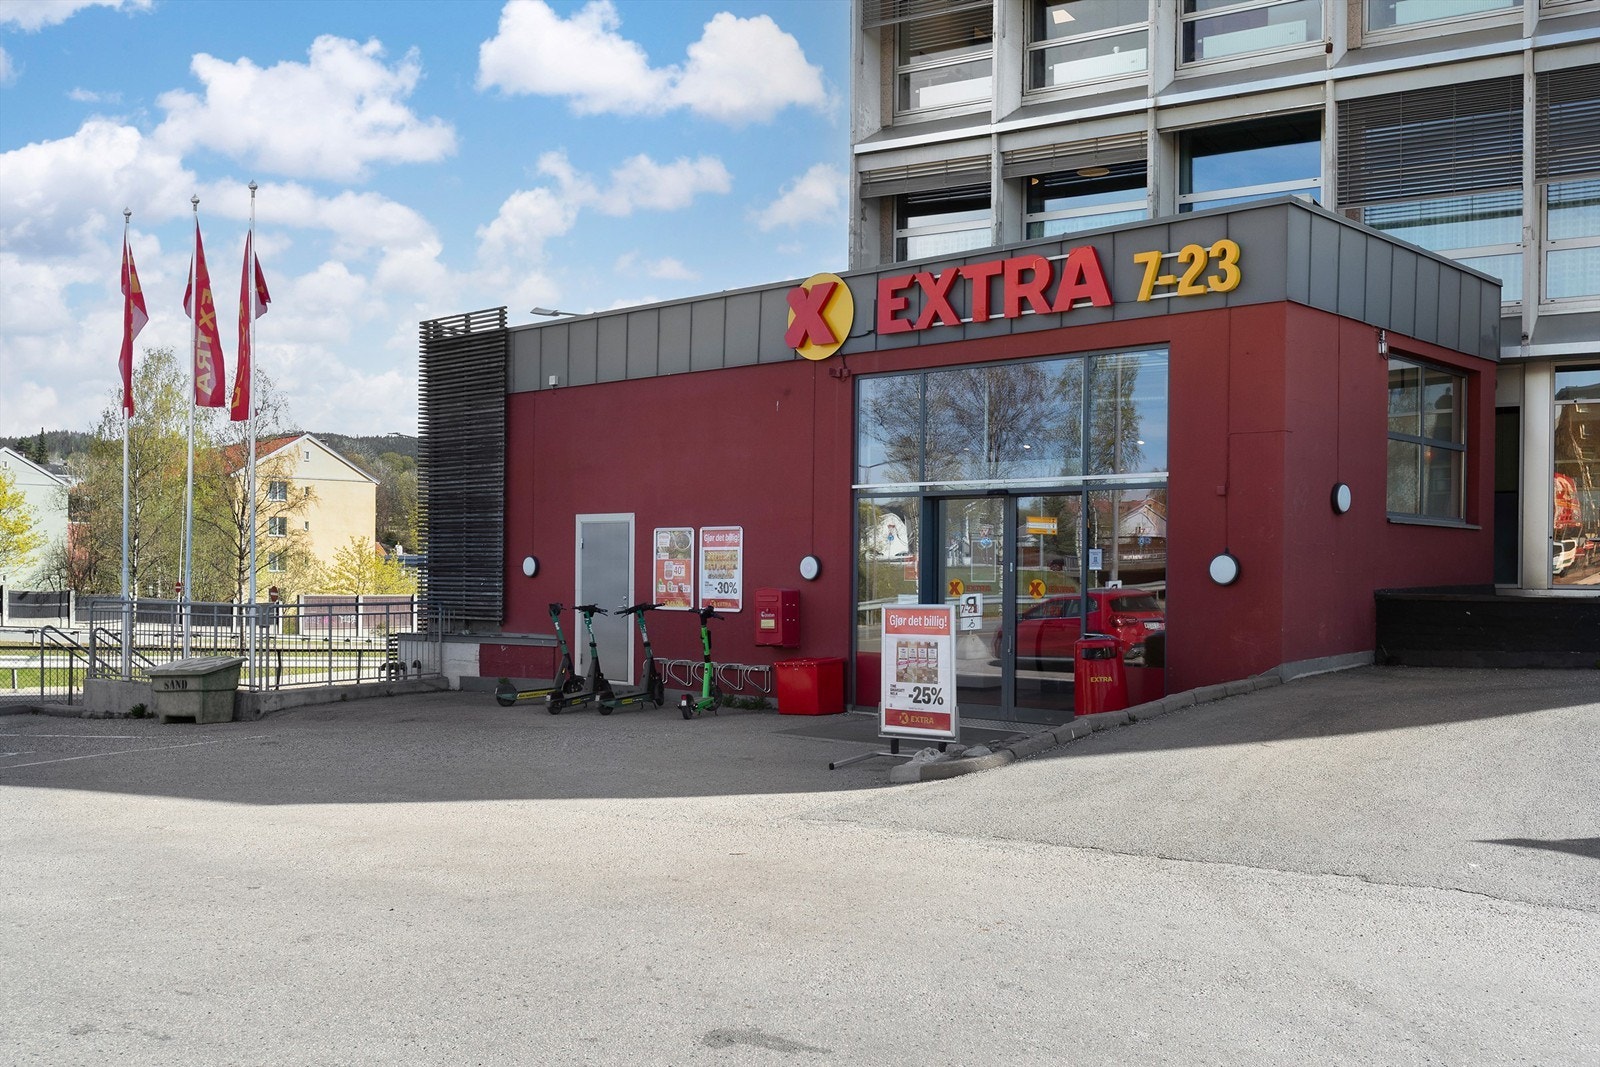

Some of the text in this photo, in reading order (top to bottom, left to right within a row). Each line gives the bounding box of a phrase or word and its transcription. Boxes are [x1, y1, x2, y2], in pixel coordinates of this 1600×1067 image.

[1133, 239, 1241, 303] 7-23
[877, 245, 1113, 335] EXTRA
[714, 581, 738, 594] -30%
[889, 614, 947, 629] Gjør det billig!
[164, 679, 188, 690] SAND
[908, 685, 944, 706] -25%
[910, 715, 934, 724] EXTRA
